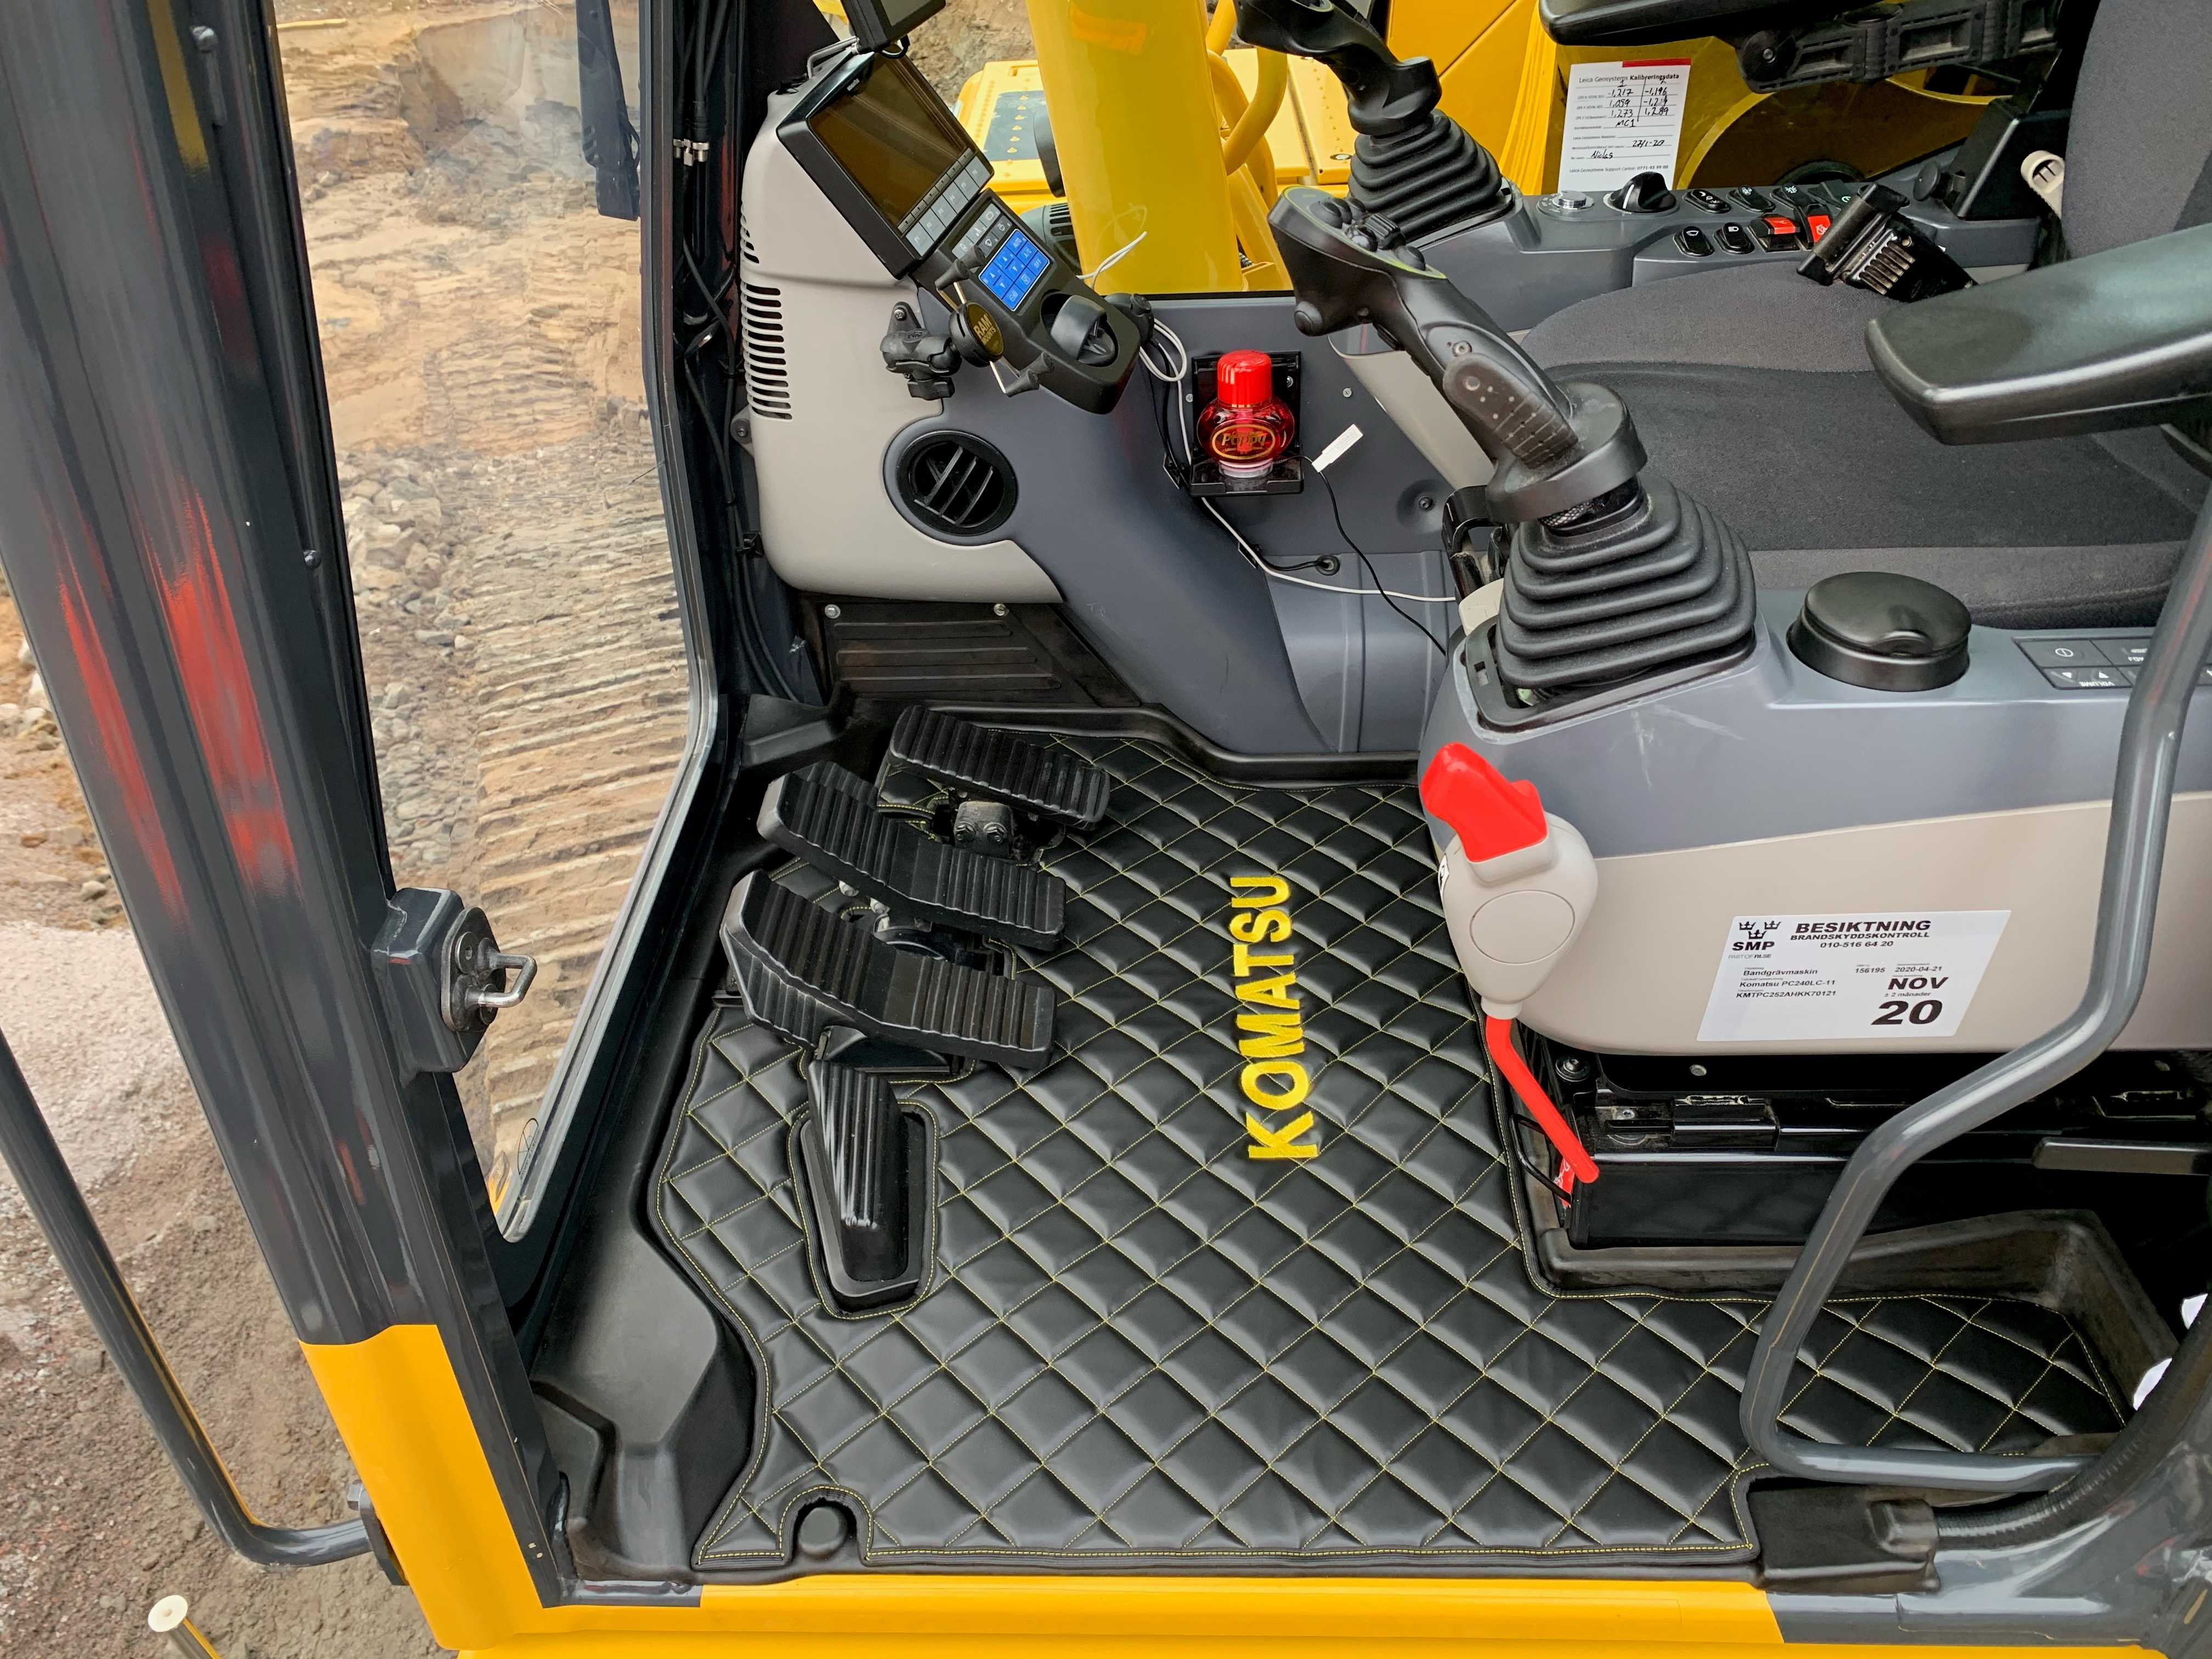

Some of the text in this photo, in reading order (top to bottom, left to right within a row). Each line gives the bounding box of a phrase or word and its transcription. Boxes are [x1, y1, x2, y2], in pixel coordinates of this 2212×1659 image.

[1013, 237, 1022, 249] AUTO
[1023, 247, 1032, 258] A/C
[1034, 258, 1042, 268] OFF
[973, 314, 992, 339] RAM
[981, 326, 996, 346] MOUNTS
[1221, 432, 1267, 446] Poppy
[1795, 920, 1931, 934] BESIKTNING
[1790, 932, 1930, 941] BRANDSKYDDSKONTROLL
[1732, 941, 1775, 951] SMP
[1742, 969, 1818, 977] Bandgrävmaskin
[1887, 977, 1950, 990] NOV
[1736, 990, 1836, 998] KMTPC252AHKK70121
[1229, 876, 1318, 1159] KOMATSU
[1870, 999, 1943, 1025] 20
